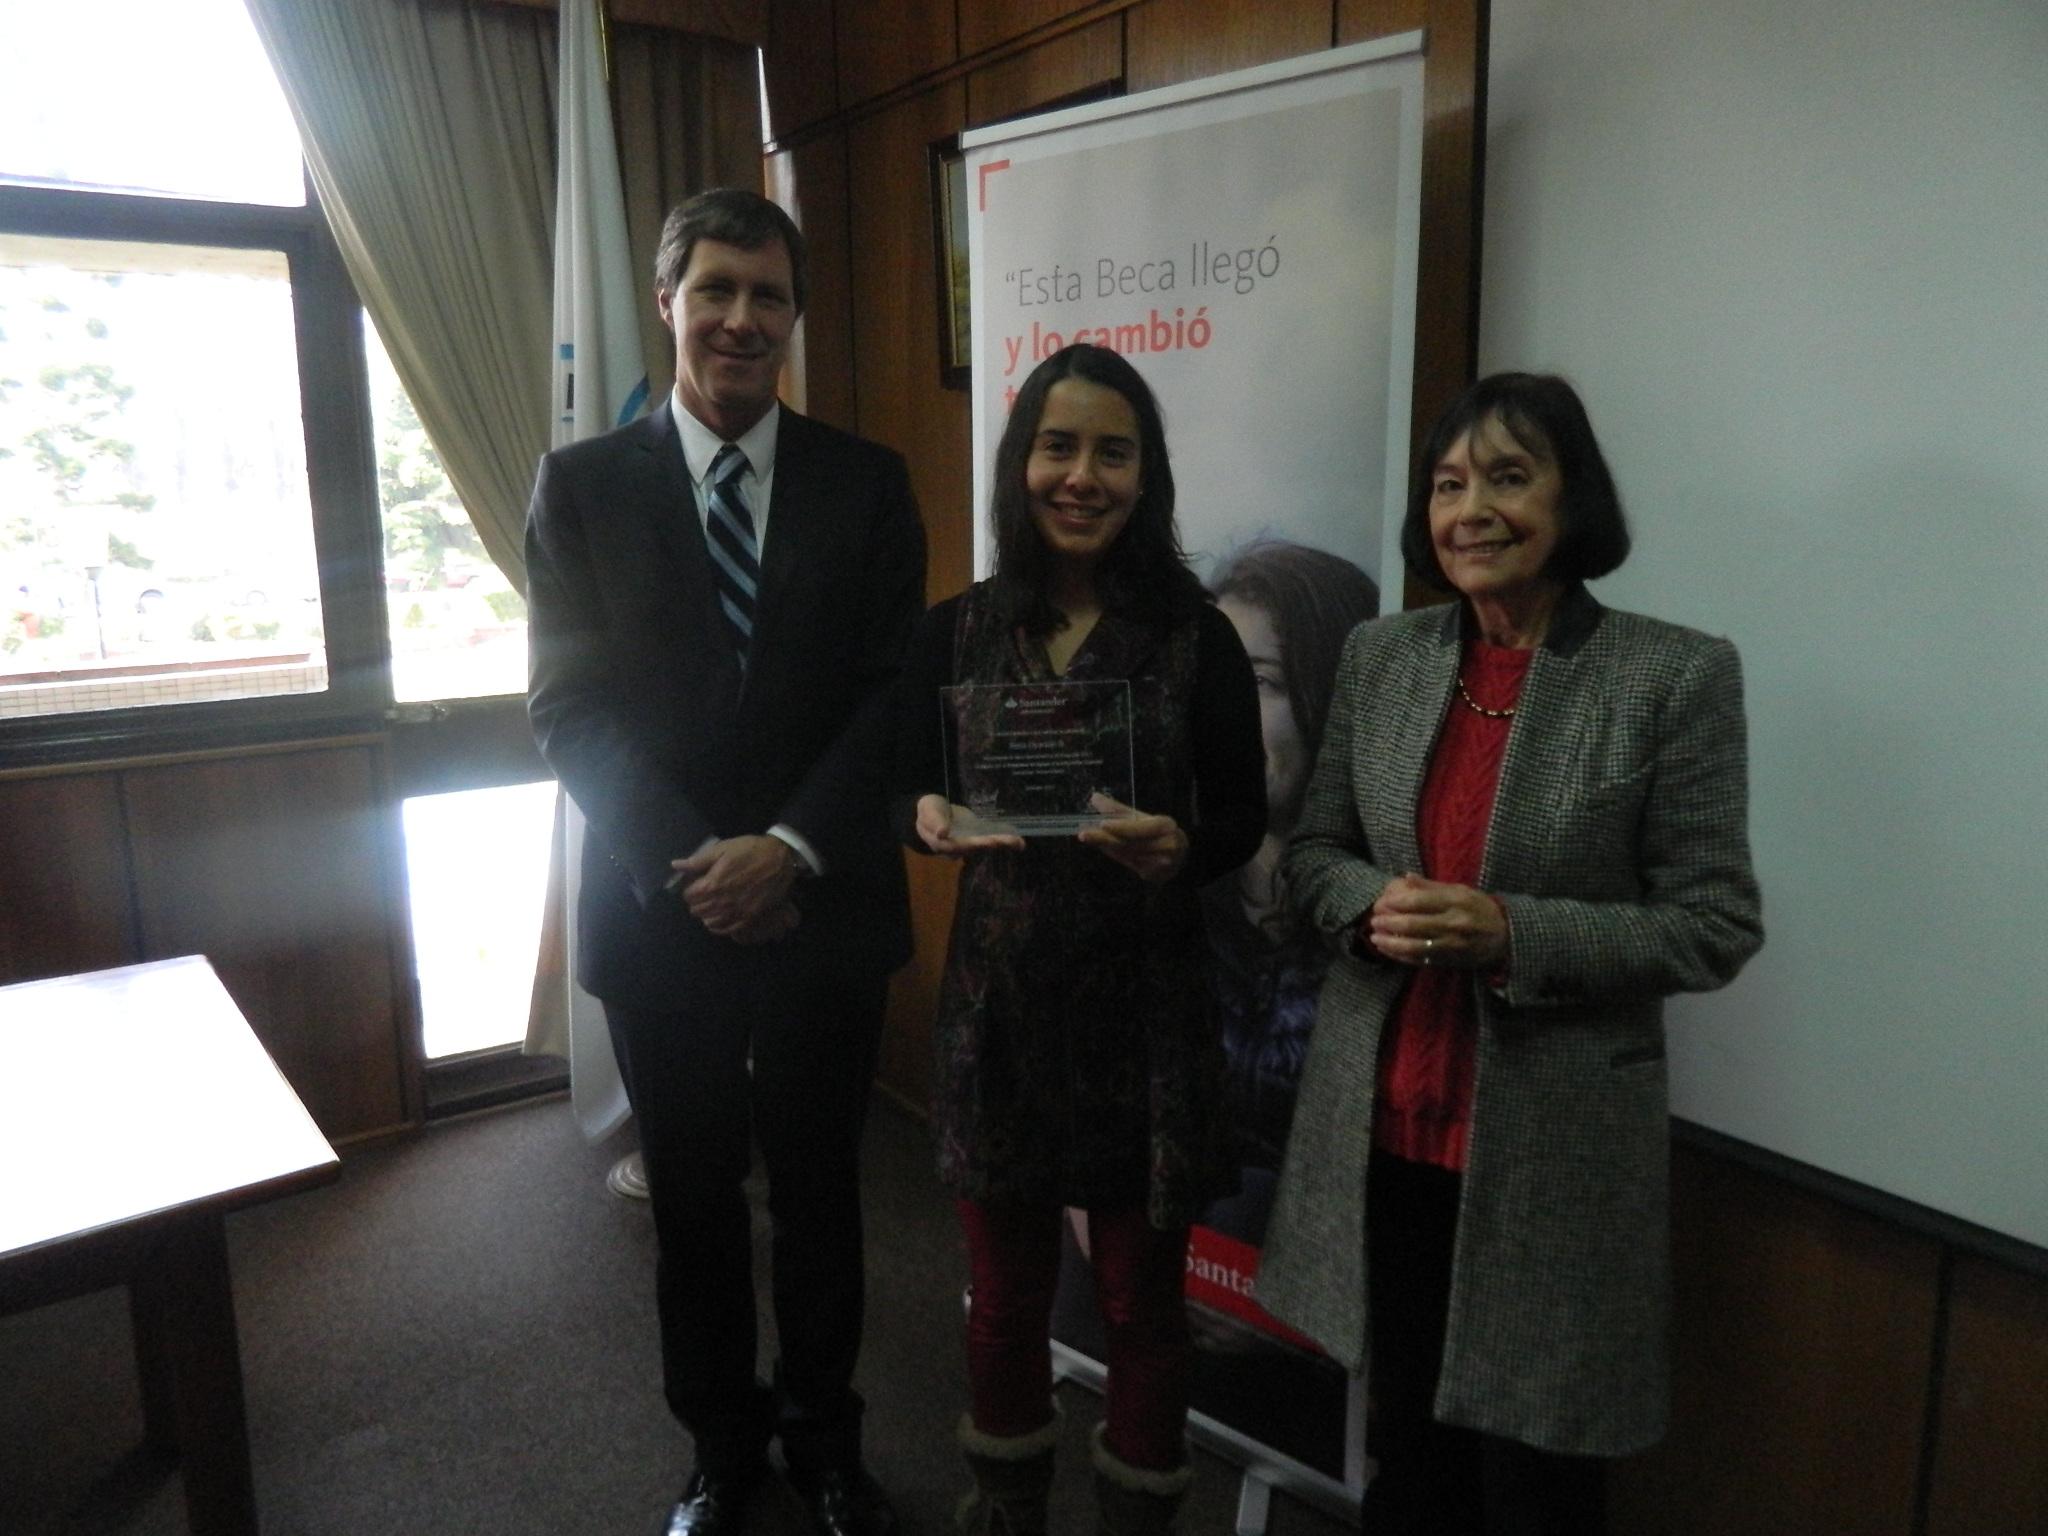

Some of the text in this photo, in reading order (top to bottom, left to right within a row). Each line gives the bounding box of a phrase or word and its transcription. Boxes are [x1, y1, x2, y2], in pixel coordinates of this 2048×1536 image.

[1097, 257, 1176, 299] Beca
[1191, 234, 1280, 295] llegó
[1004, 307, 1211, 376] y lo cambió
